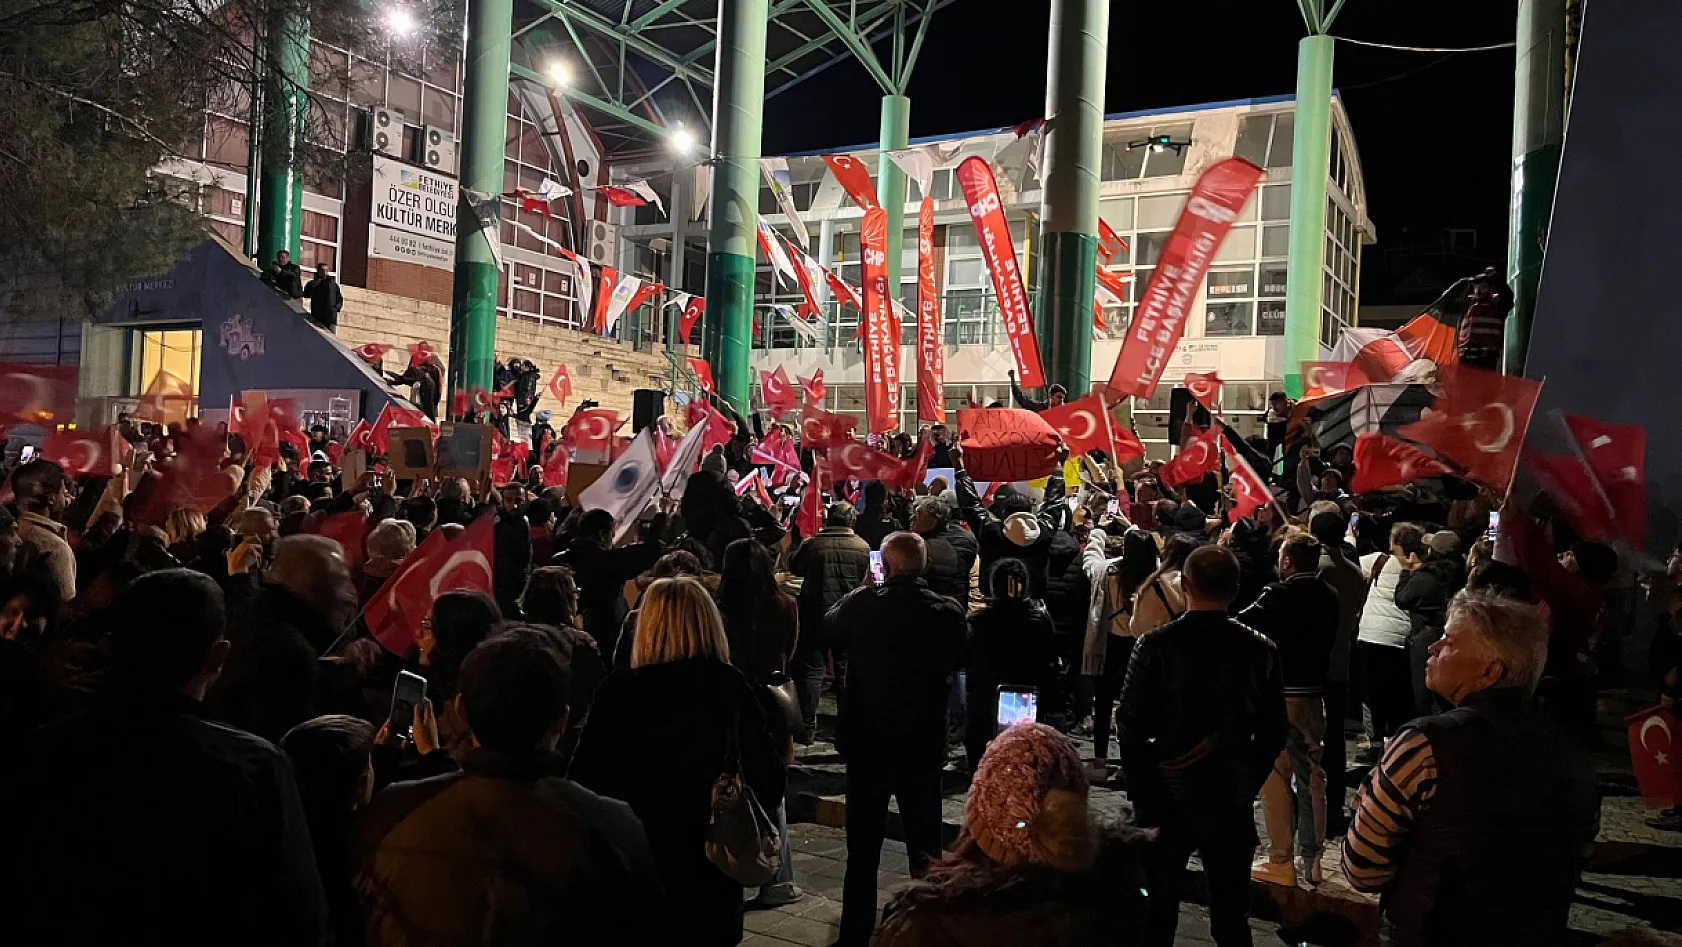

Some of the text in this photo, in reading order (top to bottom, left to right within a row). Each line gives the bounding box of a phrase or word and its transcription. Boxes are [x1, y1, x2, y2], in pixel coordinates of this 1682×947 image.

[376, 202, 422, 229] KÜLTÜR
[389, 183, 421, 209] ÖZER
[864, 248, 885, 266] CHP
[1155, 231, 1218, 344] BAŞKANLIĞI
[1136, 264, 1181, 342] FETHİYE
[868, 311, 882, 383] FETHİYE
[875, 277, 899, 418] İLÇE BAŞKANLIĞI
